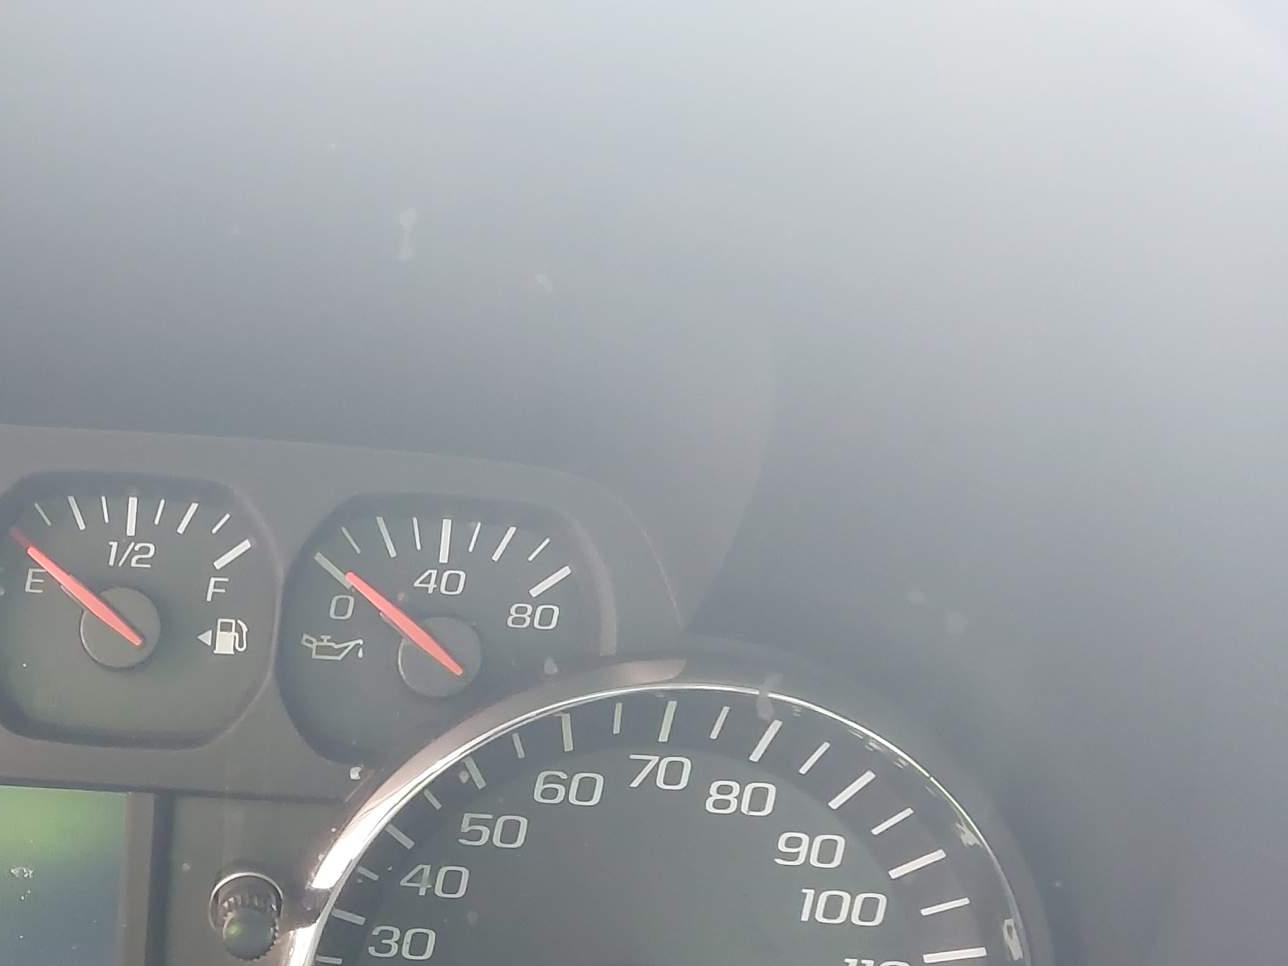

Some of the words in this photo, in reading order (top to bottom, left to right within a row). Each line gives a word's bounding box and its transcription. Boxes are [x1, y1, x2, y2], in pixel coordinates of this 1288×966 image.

[108, 541, 155, 568] 1/2
[24, 567, 45, 594] E
[206, 577, 229, 602] F
[413, 569, 466, 595] 40
[329, 594, 355, 620] 0
[507, 603, 560, 630] 80
[533, 770, 604, 806] 60
[629, 754, 692, 790] 70
[705, 780, 777, 817] 80
[458, 813, 528, 849] 50
[774, 832, 846, 868] 90
[399, 864, 470, 899] 40
[800, 888, 887, 926] 100
[368, 925, 436, 960] 30
